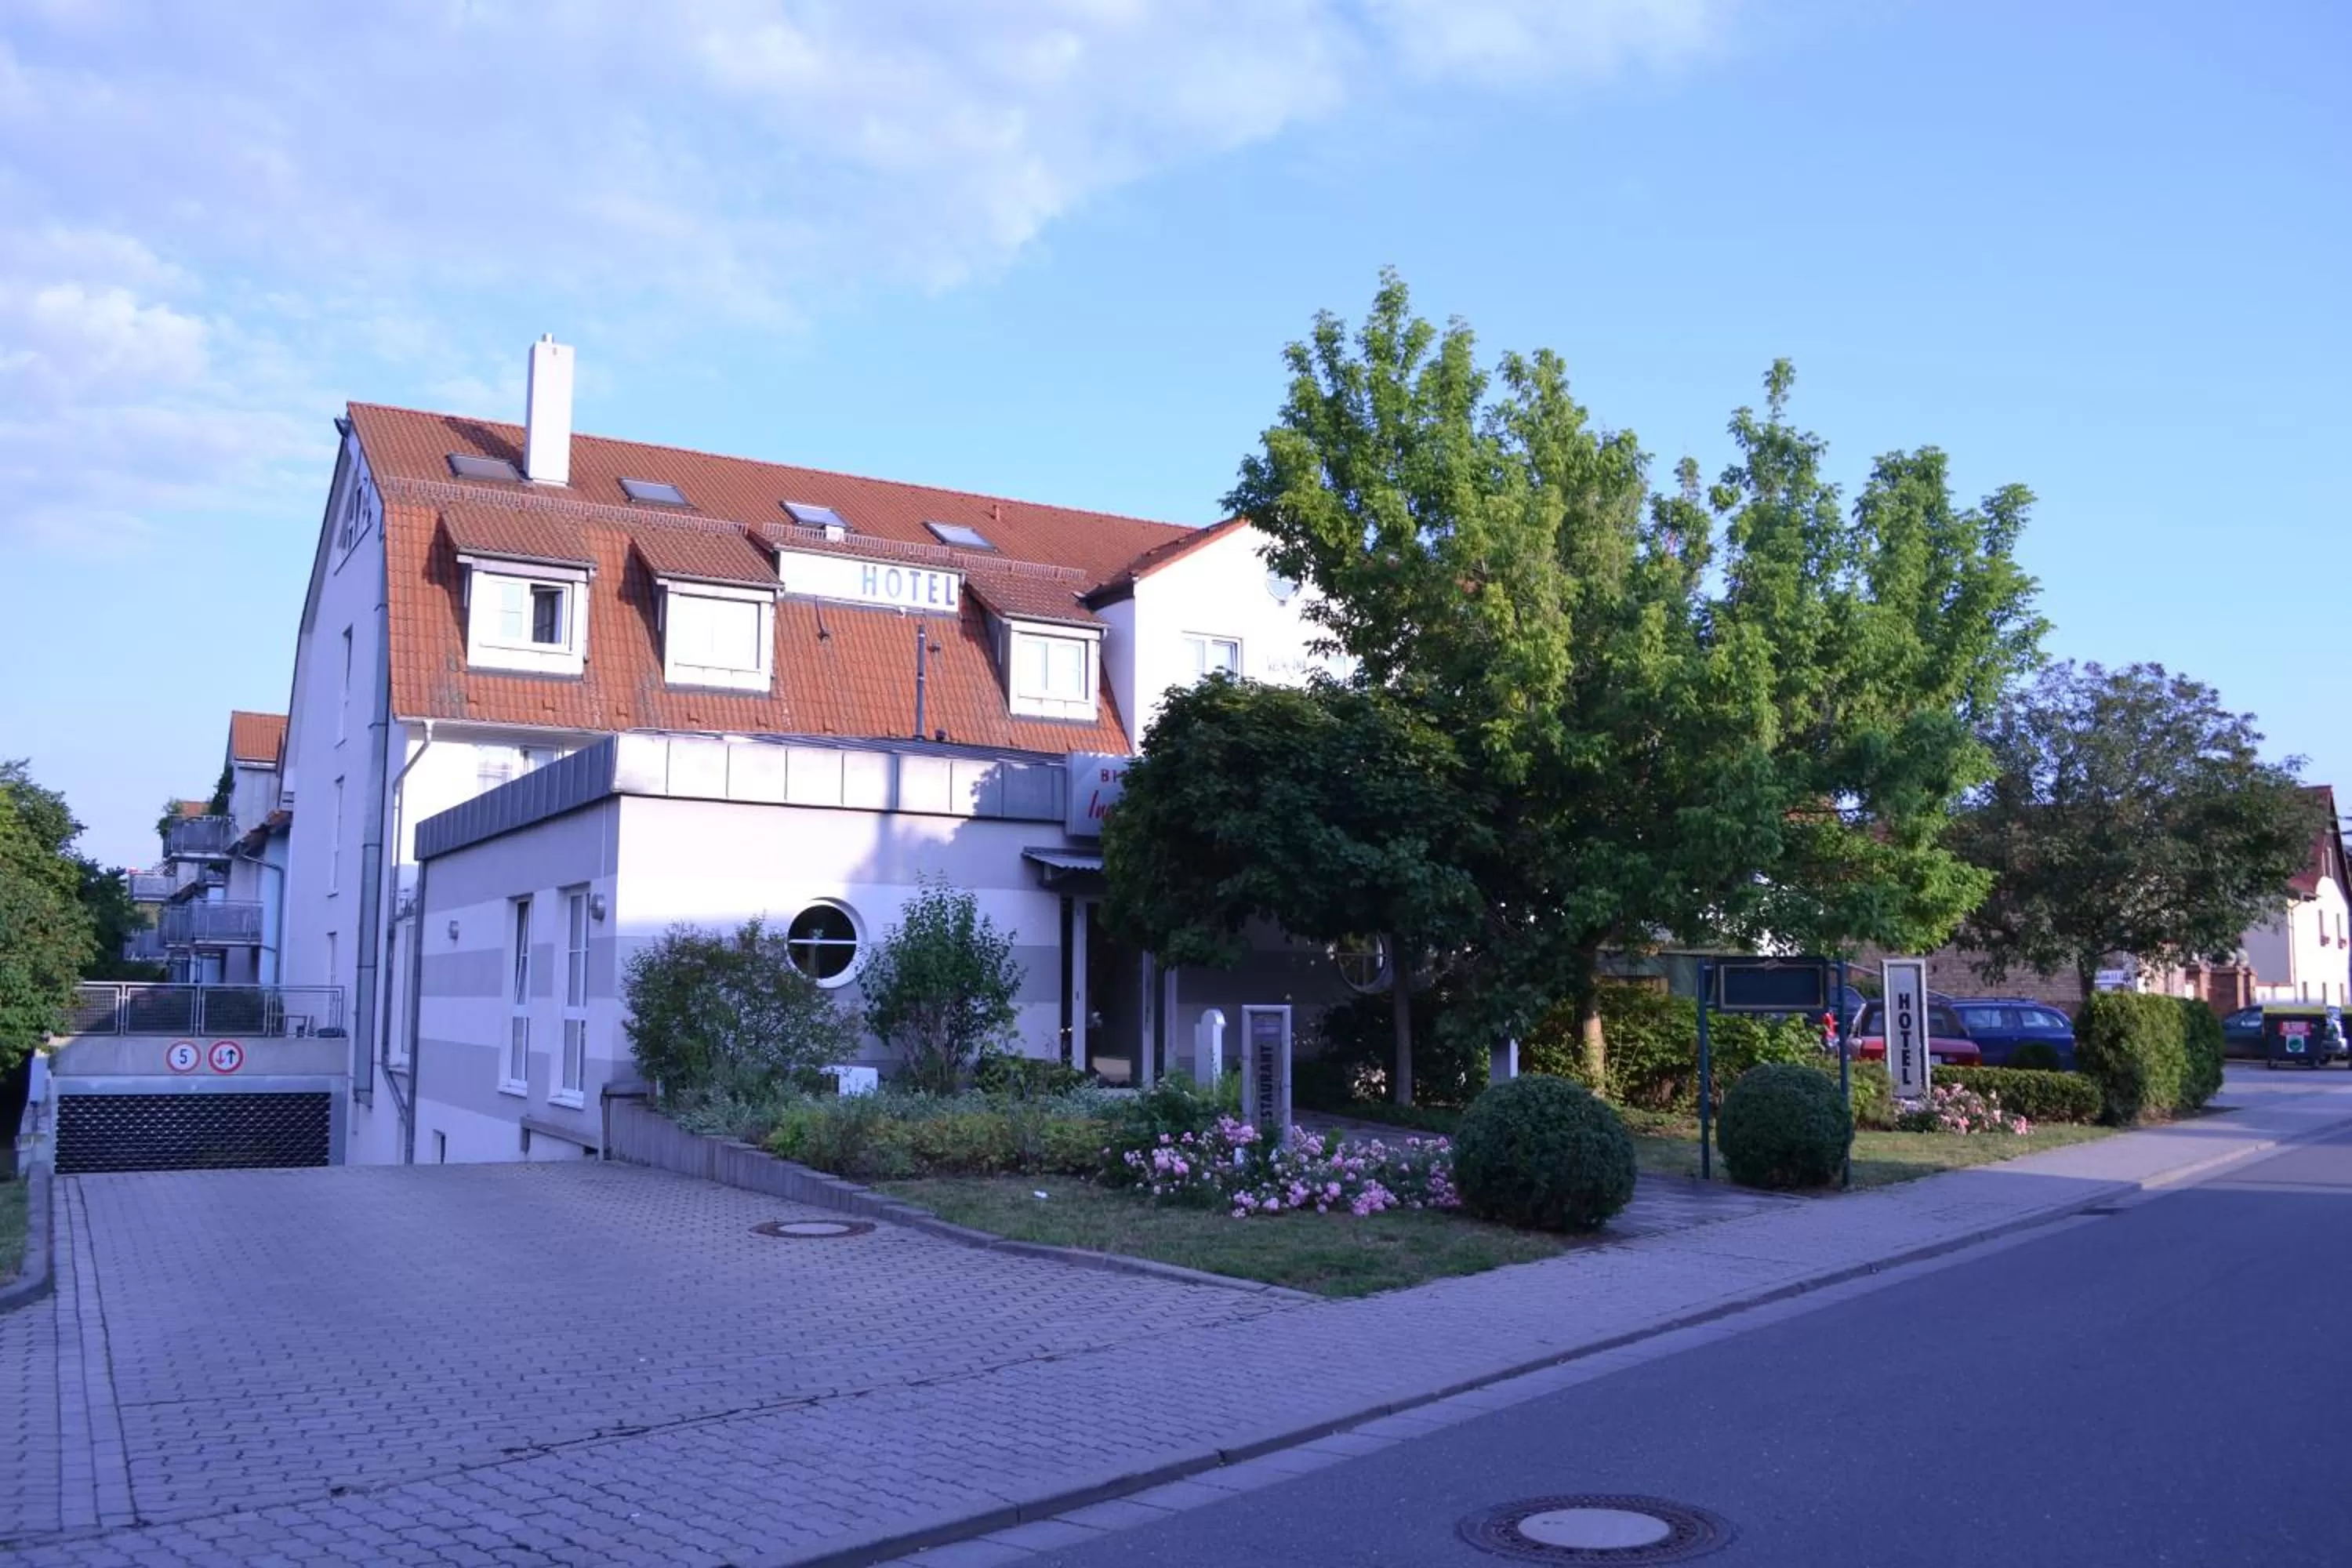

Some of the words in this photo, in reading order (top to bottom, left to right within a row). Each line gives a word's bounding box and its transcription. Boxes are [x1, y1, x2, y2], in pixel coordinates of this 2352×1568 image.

[862, 564, 955, 605] HOTEL
[179, 1048, 188, 1065] 5
[1898, 993, 1912, 1085] HOTEL
[1260, 1044, 1274, 1123] STAURANT
